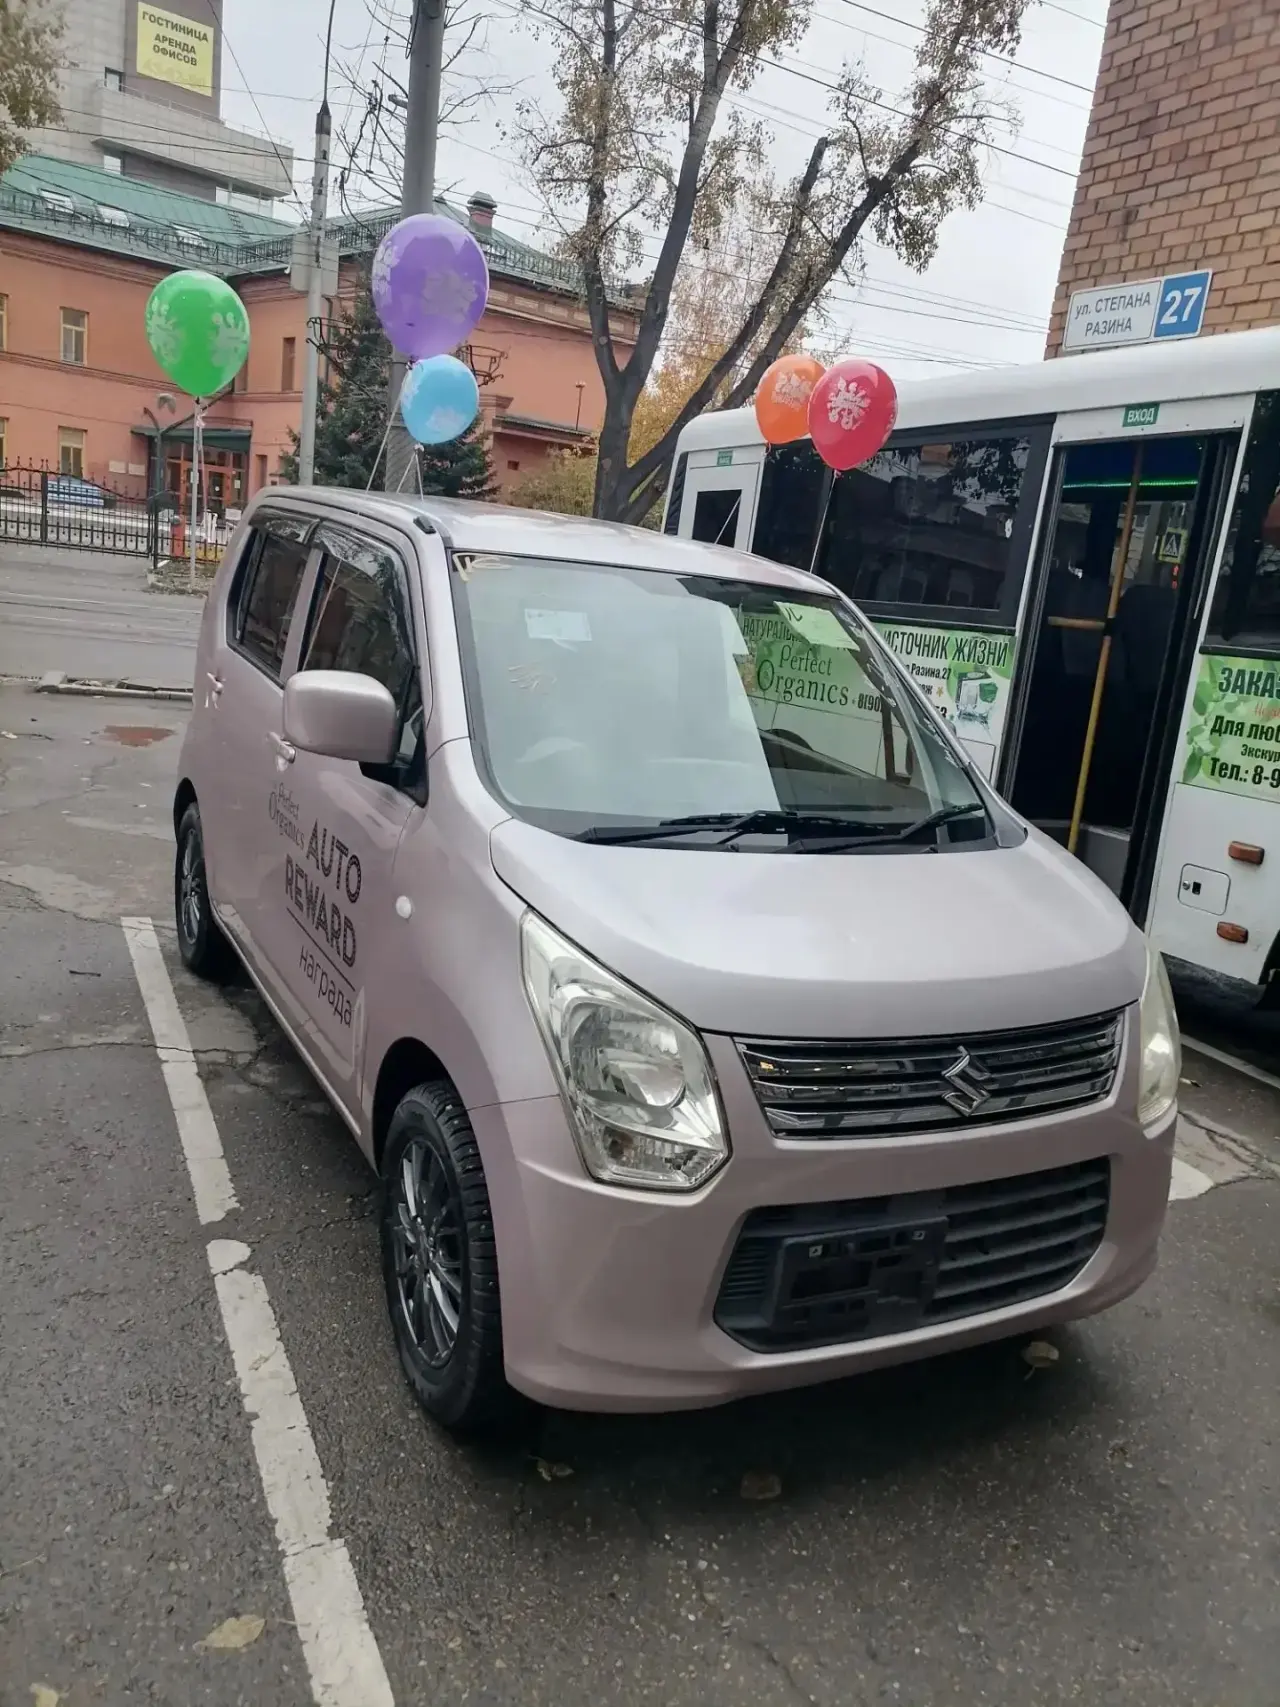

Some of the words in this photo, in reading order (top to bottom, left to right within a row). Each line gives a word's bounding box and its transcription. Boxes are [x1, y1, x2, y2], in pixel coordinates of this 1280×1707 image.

[142, 11, 209, 43] ГОСТИНИЦА
[153, 44, 198, 67] ОФИСОВ
[154, 33, 196, 55] АРЕНДА
[1074, 304, 1092, 319] ул.
[1094, 291, 1151, 314] СТЕПАНА
[1160, 286, 1203, 325] 27
[1085, 317, 1132, 337] РАЗИНА
[1127, 407, 1156, 424] ВХОД
[779, 644, 833, 676] Perfect
[952, 636, 1009, 668] ЖИЗНИ
[757, 659, 849, 706] Organics
[1210, 715, 1245, 738] Для
[1210, 757, 1249, 783] Тел.:
[305, 818, 362, 904] AUTO
[285, 853, 357, 969] REWARD
